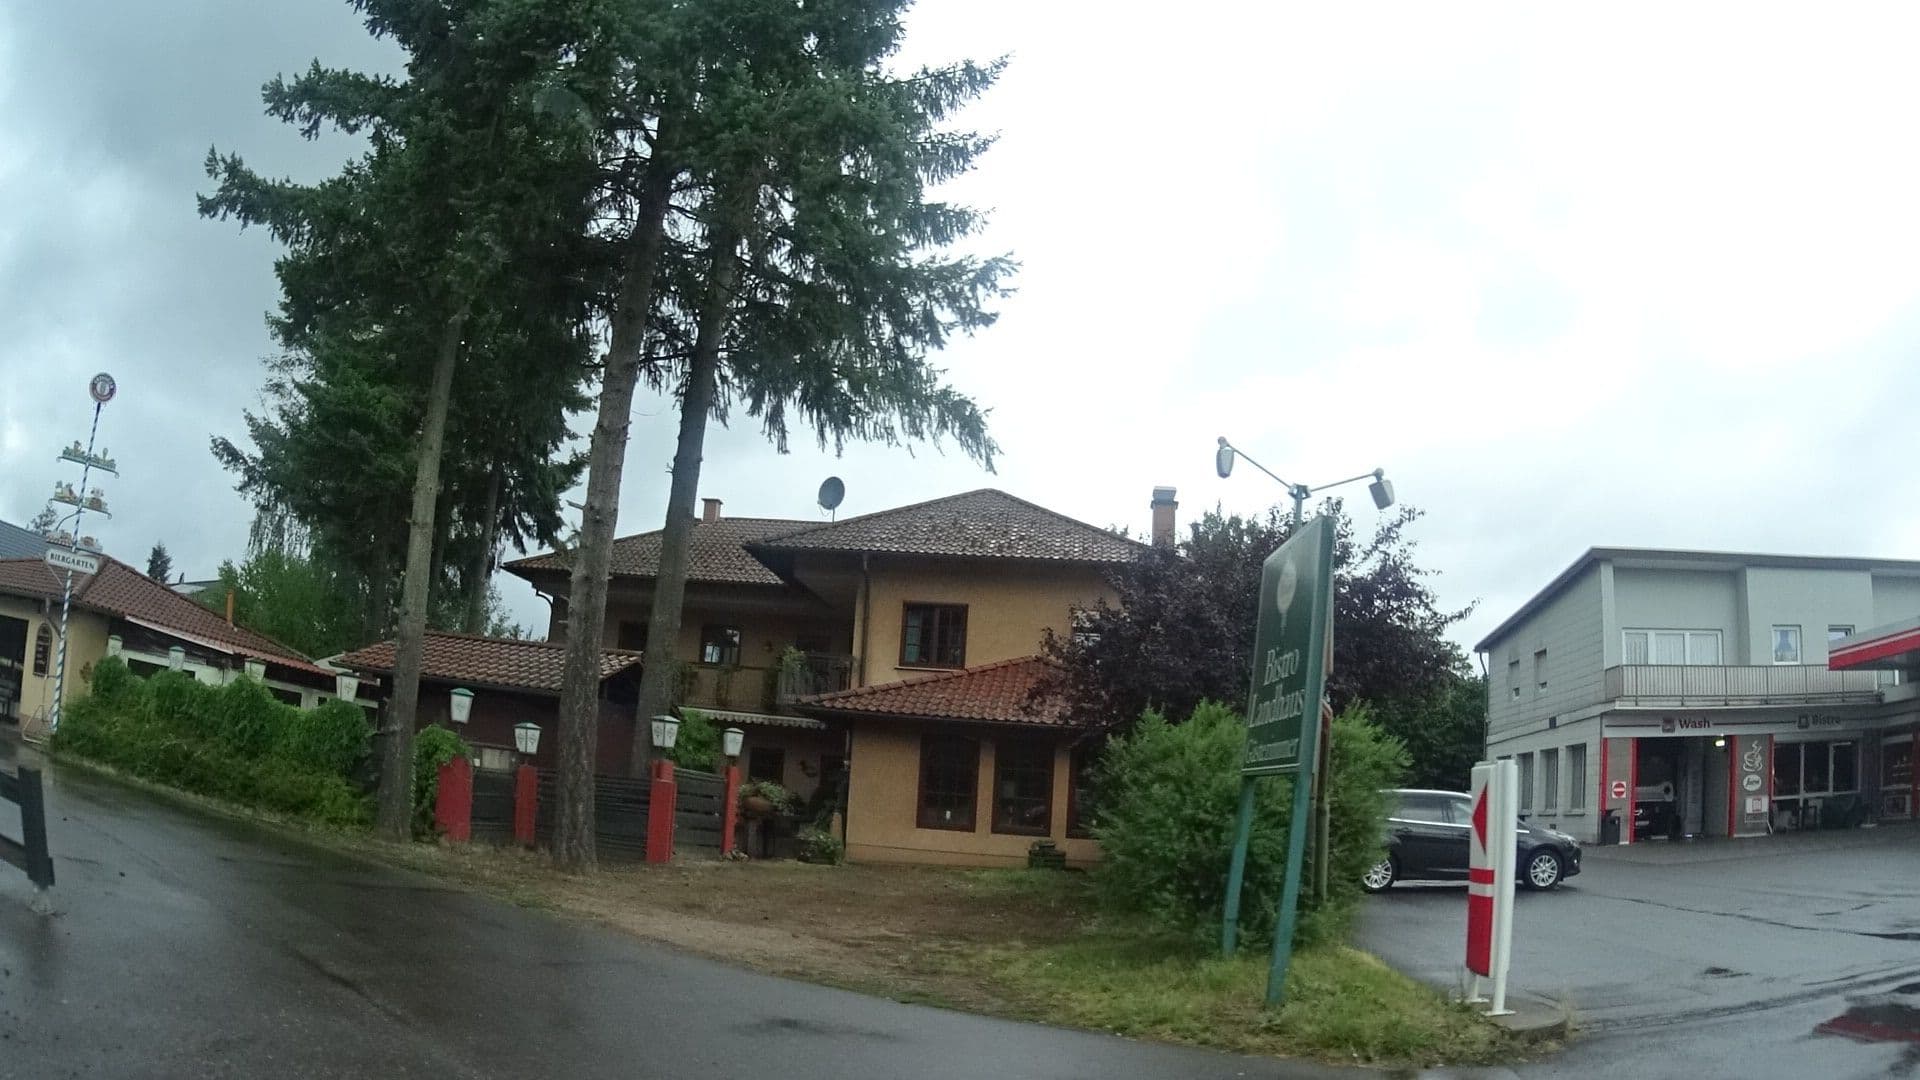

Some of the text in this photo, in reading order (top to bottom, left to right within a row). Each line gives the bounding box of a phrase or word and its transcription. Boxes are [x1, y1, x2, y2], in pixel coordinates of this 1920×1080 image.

[50, 553, 95, 570] BIERGARTEN
[1264, 647, 1300, 686] Bistro
[1679, 718, 1711, 729] Wash
[1811, 712, 1842, 725] Bistro
